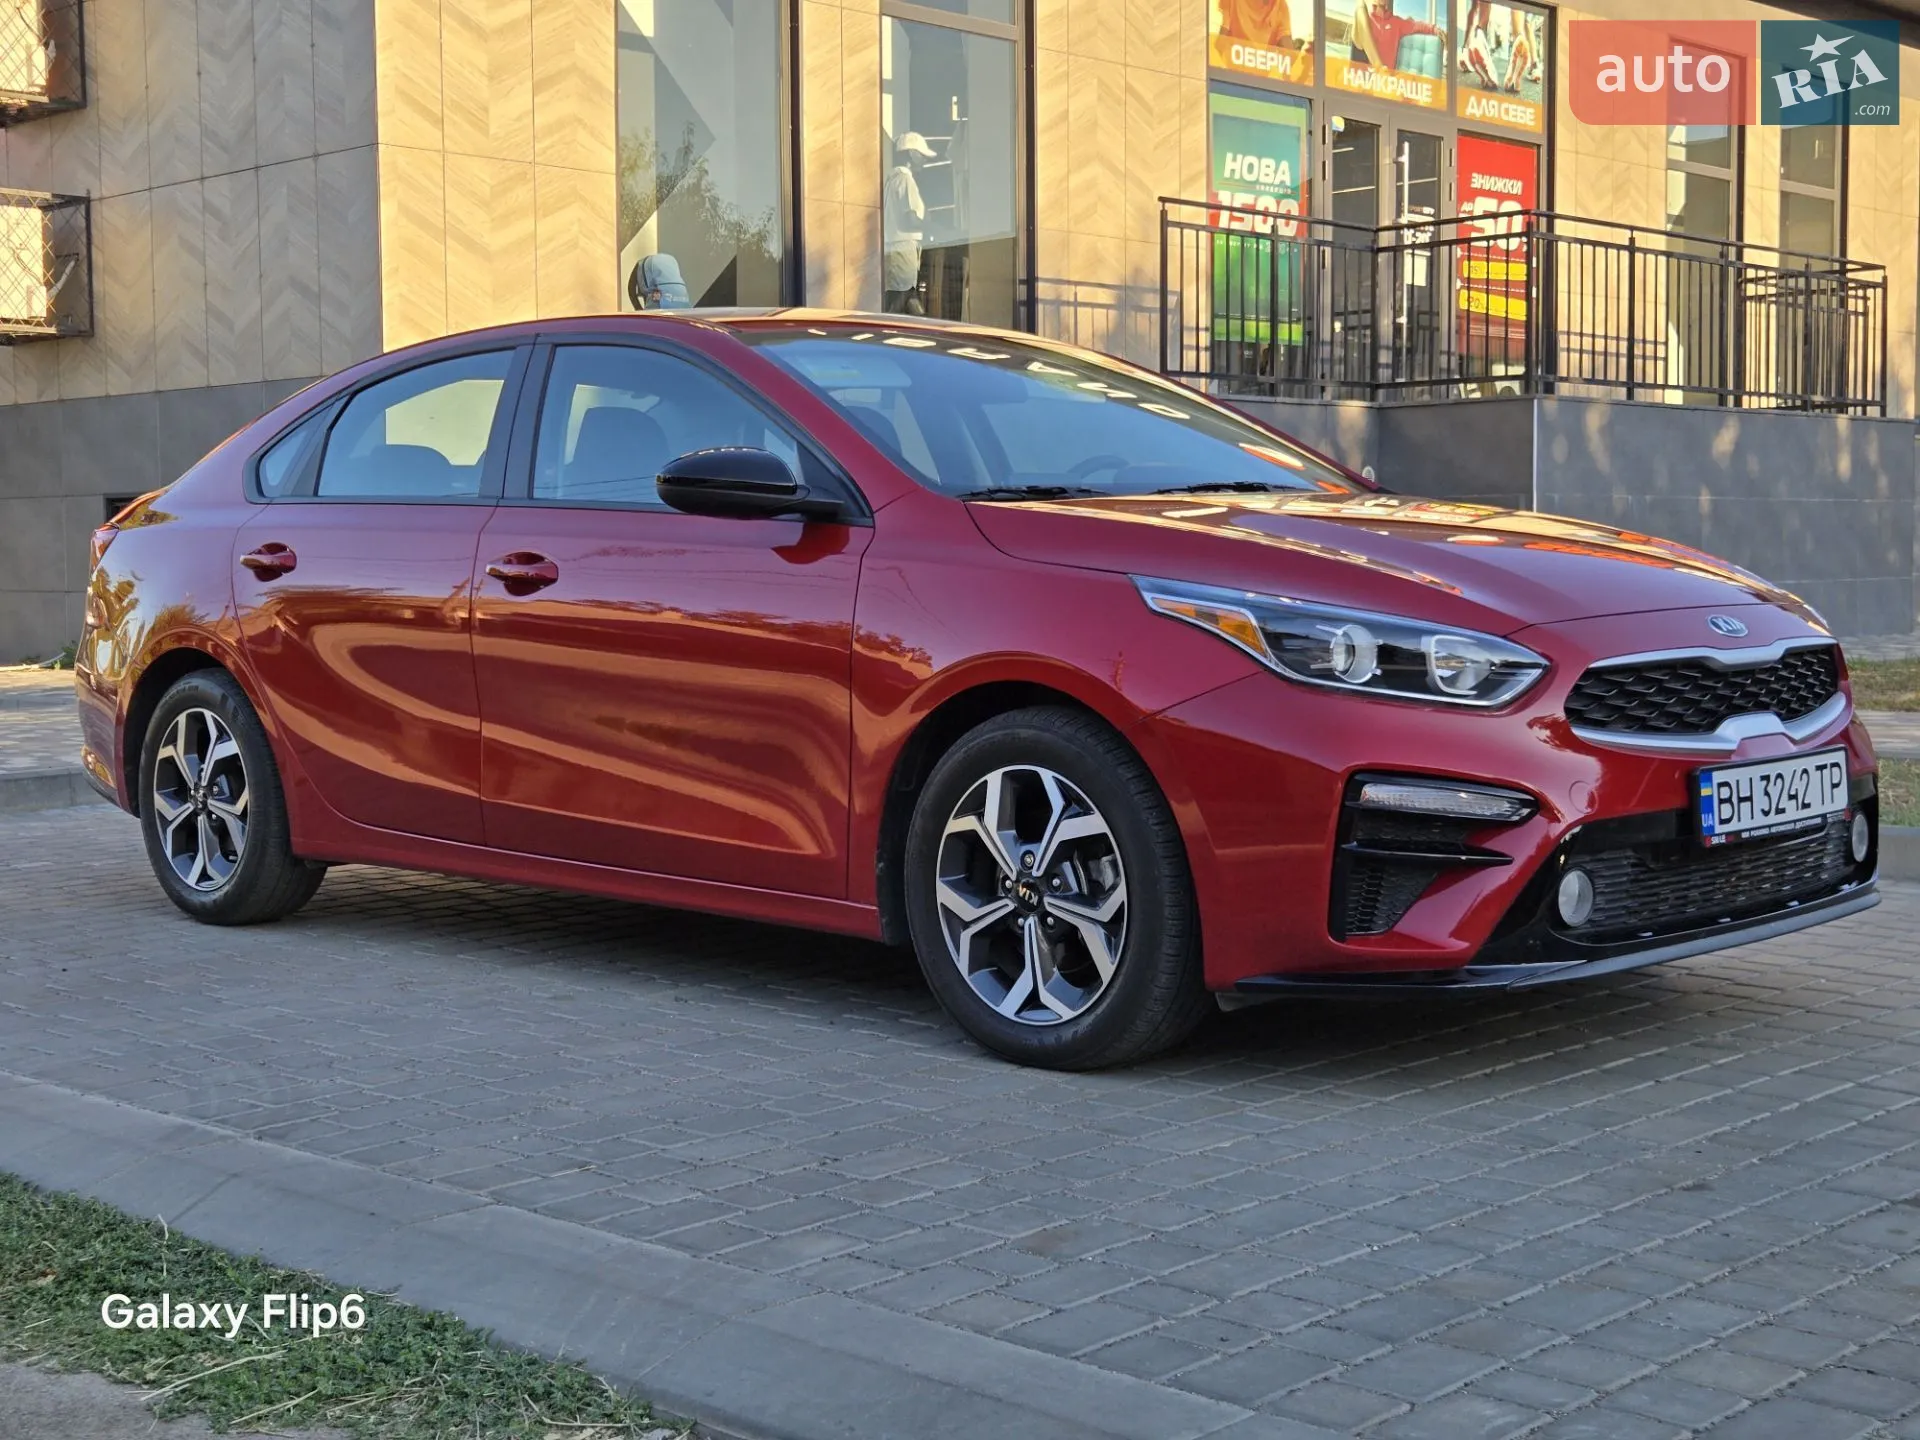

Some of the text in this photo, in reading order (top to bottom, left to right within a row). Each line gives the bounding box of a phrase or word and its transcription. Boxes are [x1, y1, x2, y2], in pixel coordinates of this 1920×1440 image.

[1231, 45, 1291, 75] ОБЕРИ
[1343, 66, 1433, 103] НАЙКРАЩЕ
[1465, 95, 1536, 126] ДЛЯ СЕБЕ
[1224, 152, 1291, 186] НОВА
[1471, 172, 1523, 196] ЗНИЖКИ
[1711, 617, 1746, 632] KIA
[1717, 761, 1843, 826] BH 3242 TP
[1701, 813, 1714, 828] UA
